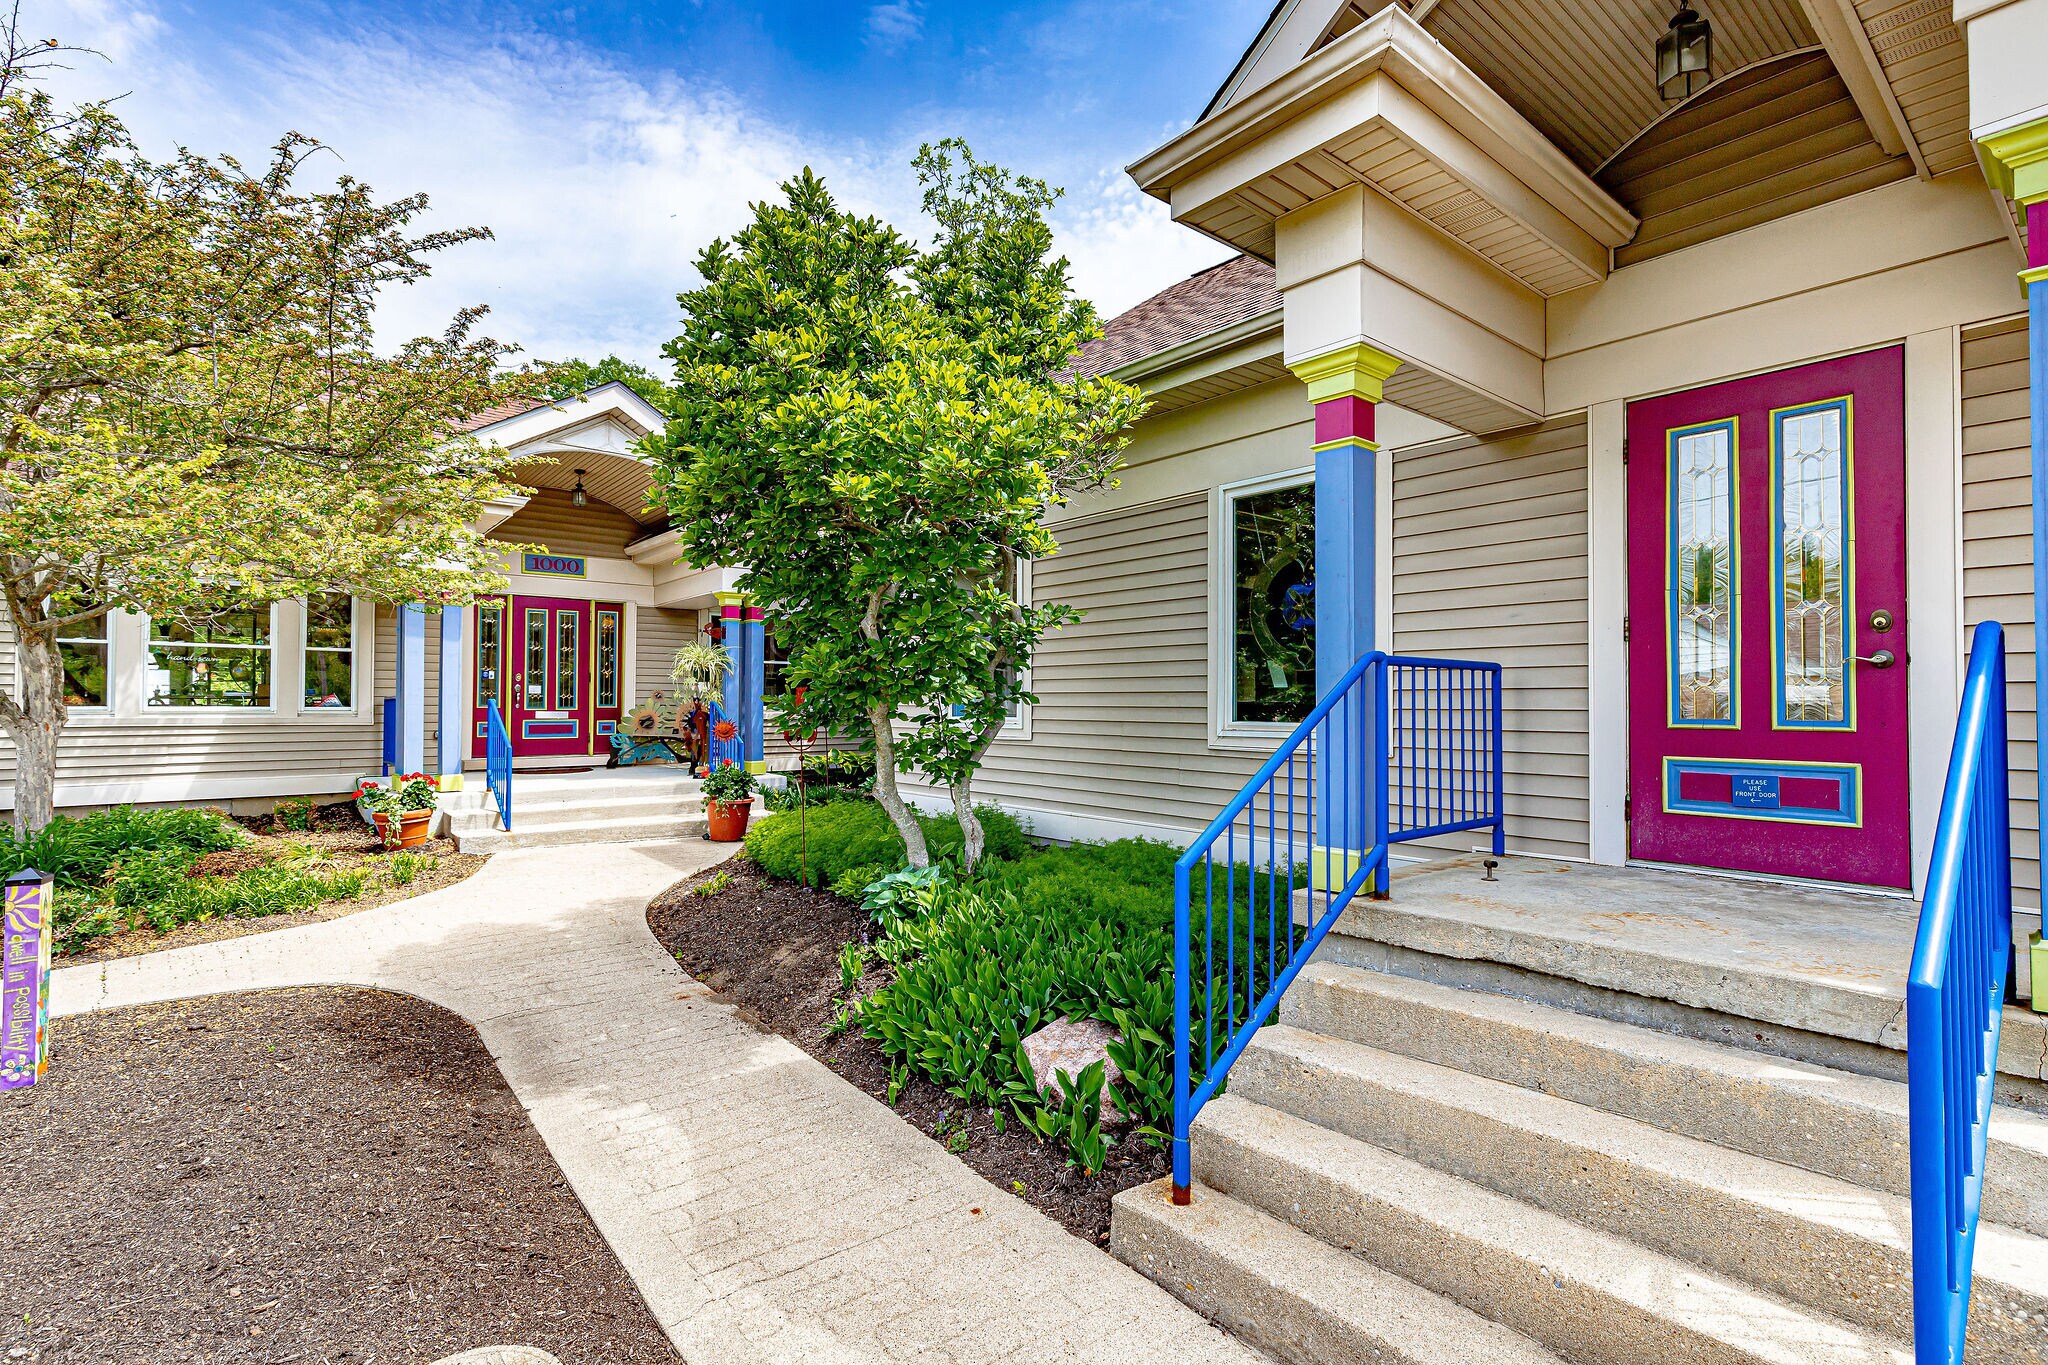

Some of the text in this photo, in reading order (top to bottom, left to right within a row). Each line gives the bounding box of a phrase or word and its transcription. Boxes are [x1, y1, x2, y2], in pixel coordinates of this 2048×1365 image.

[532, 557, 580, 573] 1000
[8, 934, 38, 966] dwell
[8, 969, 29, 983] in
